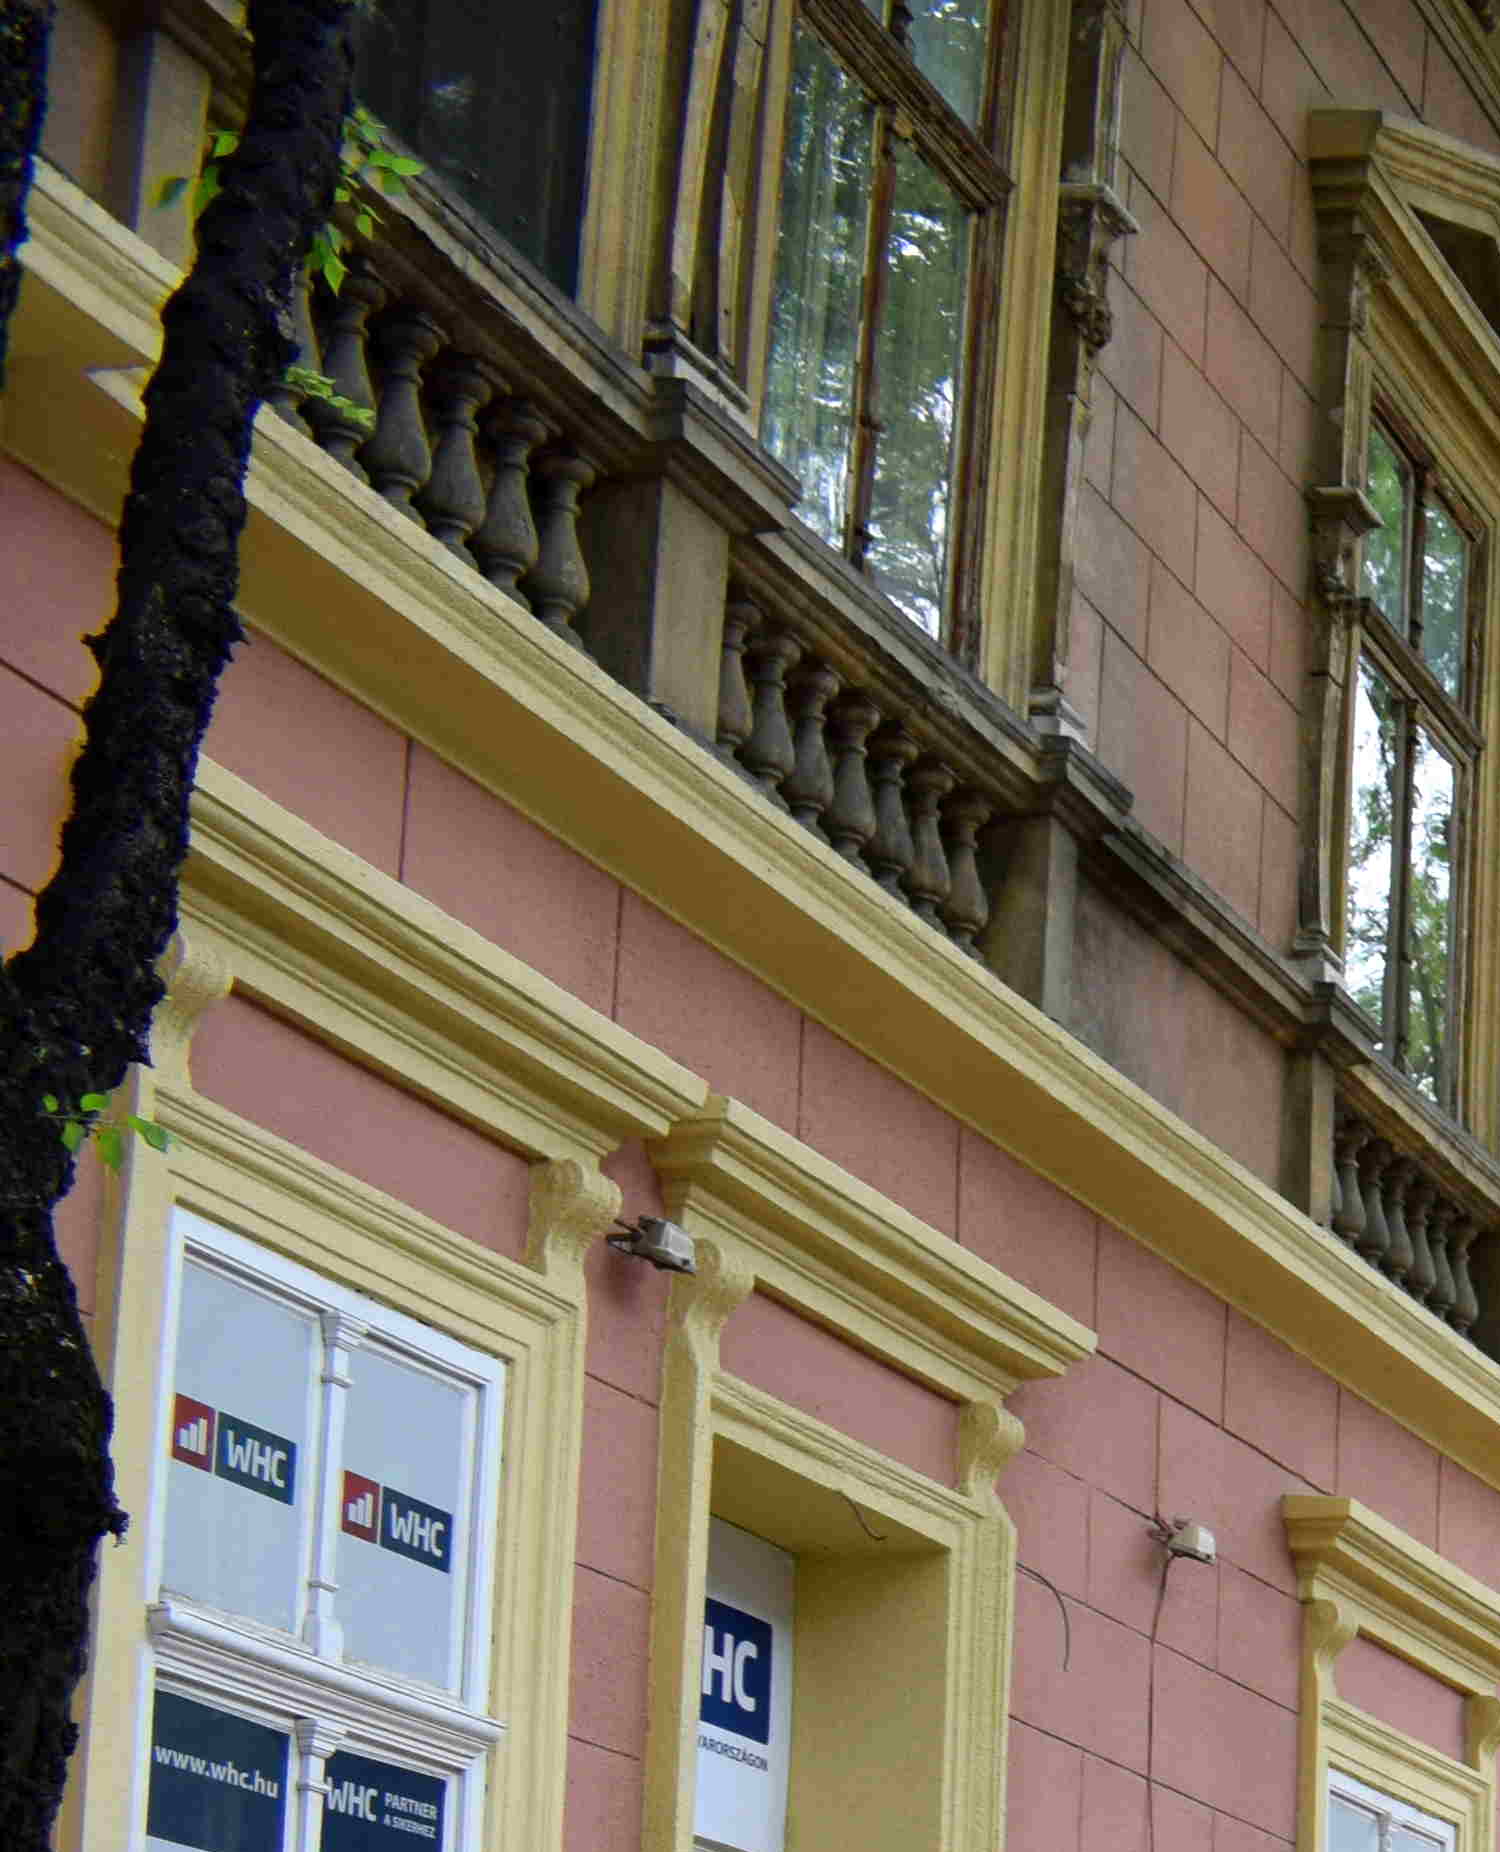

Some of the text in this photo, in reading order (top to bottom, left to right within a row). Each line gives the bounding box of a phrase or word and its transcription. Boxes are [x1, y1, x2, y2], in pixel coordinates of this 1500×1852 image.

[227, 1429, 287, 1488] WHC
[390, 1503, 445, 1557] WHC
[154, 1745, 278, 1799] www.whc.hu
[327, 1776, 437, 1822] WHC PARTNER
